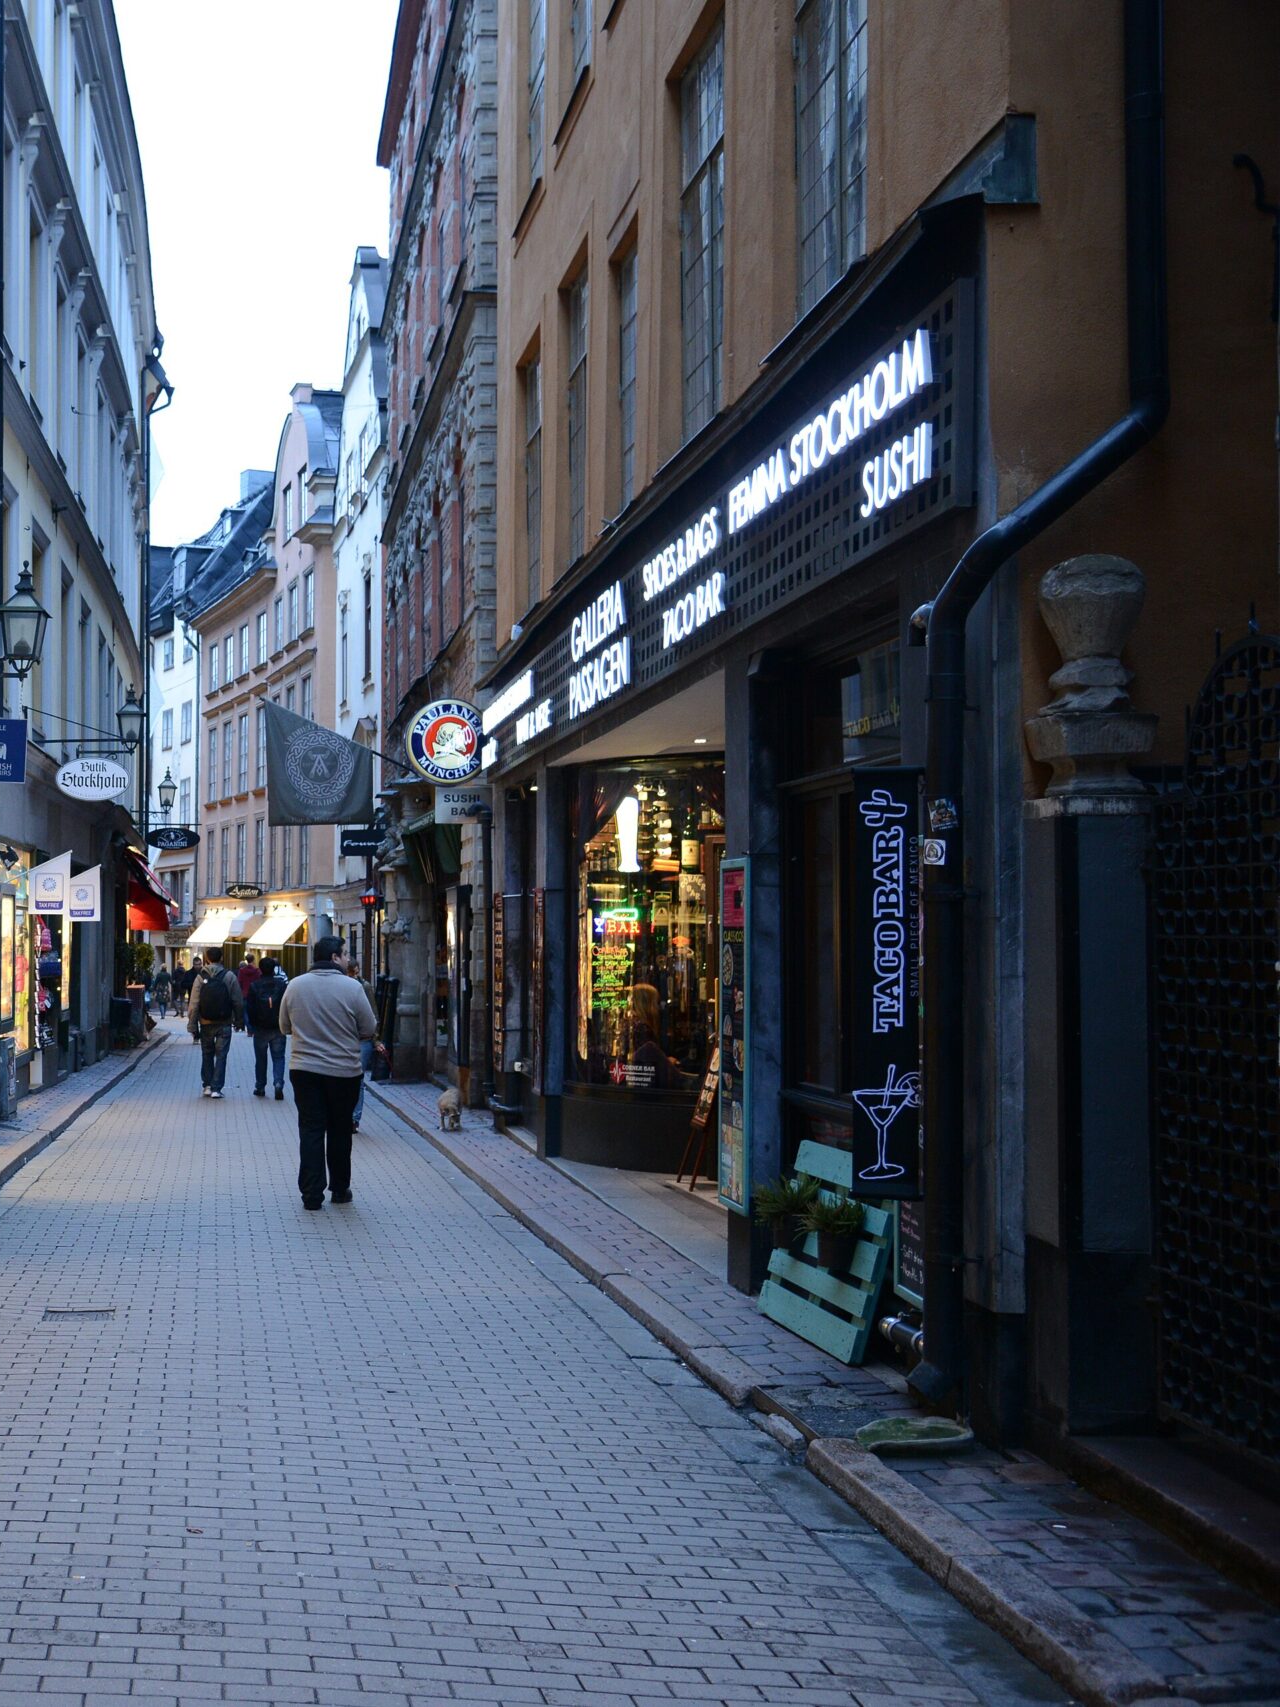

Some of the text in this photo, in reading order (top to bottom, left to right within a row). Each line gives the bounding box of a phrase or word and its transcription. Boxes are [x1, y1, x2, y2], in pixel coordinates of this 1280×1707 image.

[729, 328, 933, 534] FEMINA STOCKHOLM
[861, 422, 933, 518] SUSHI
[643, 543, 677, 601] SHOES
[686, 507, 718, 567] BAGS
[571, 580, 627, 662] GALLERIA
[662, 572, 726, 649] TACO BAR
[570, 636, 630, 720] PASSAGEN
[413, 704, 482, 736] PAULANER
[61, 772, 126, 790] Stockholm
[80, 761, 107, 772] Butik
[451, 807, 474, 816] BA
[228, 886, 259, 898] Agaton
[606, 919, 640, 933] BAR
[873, 825, 906, 1034] TACO BAR
[909, 836, 919, 998] SMALL PIECE OF MEXICO
